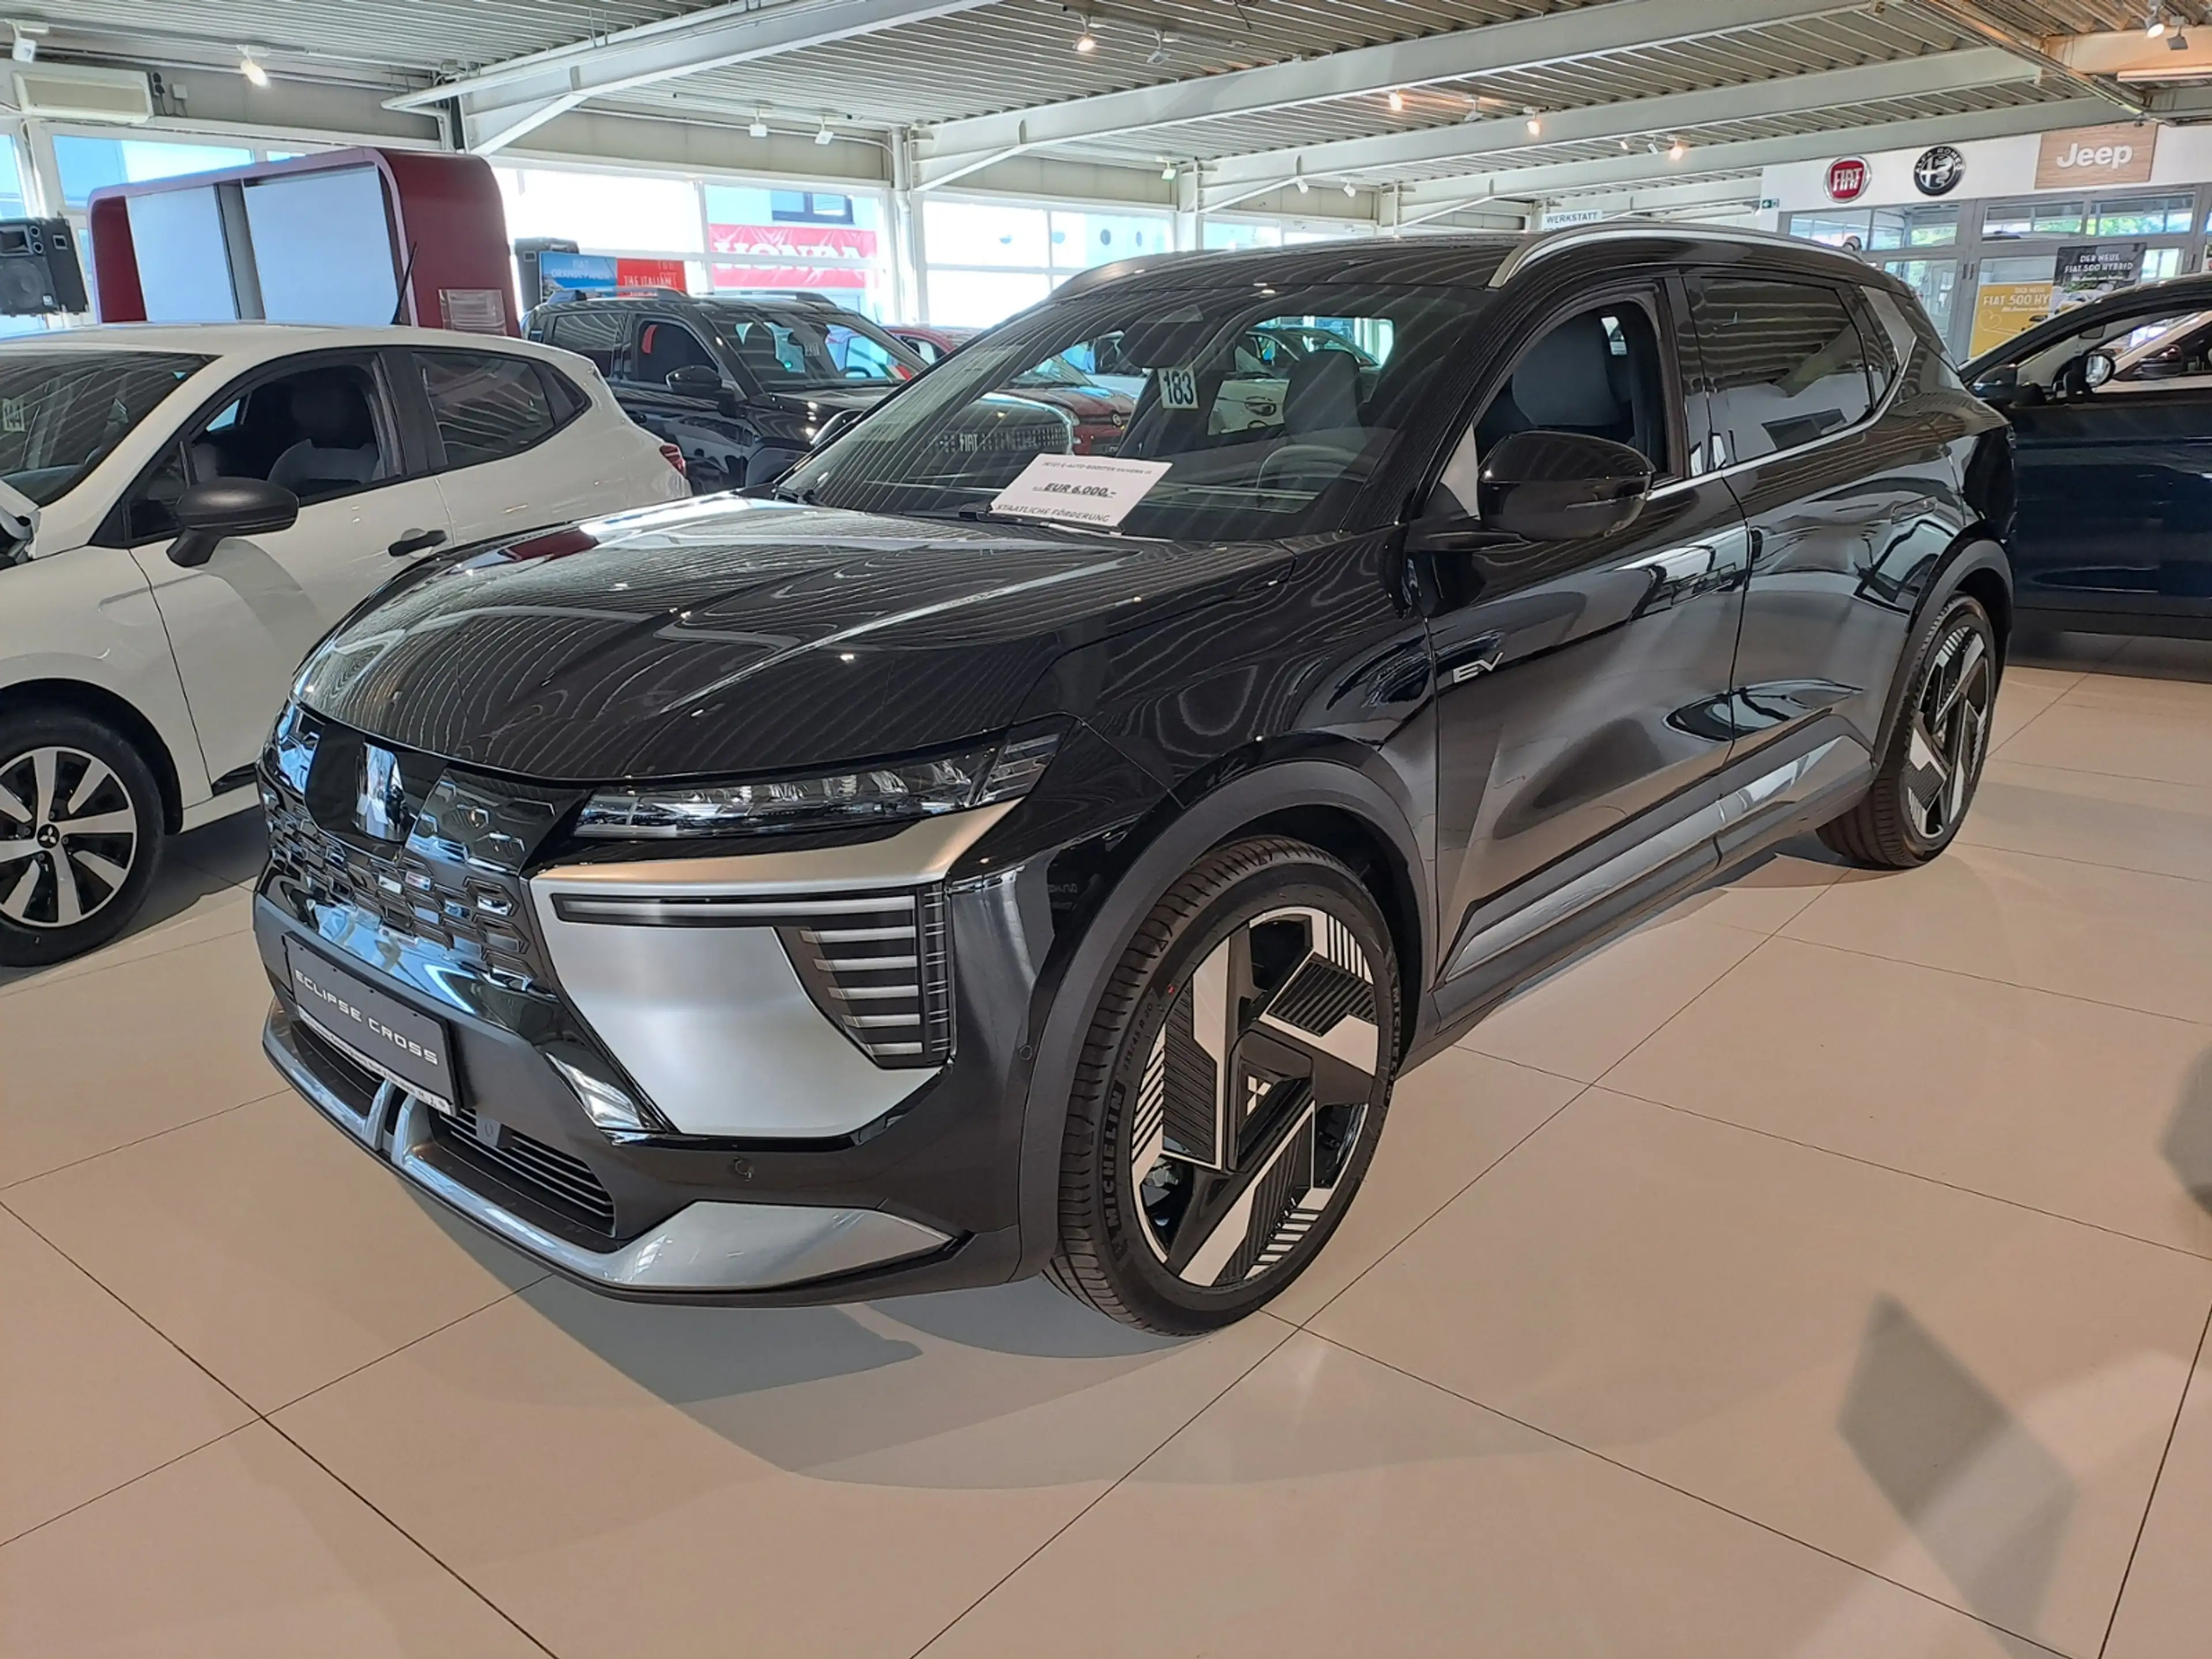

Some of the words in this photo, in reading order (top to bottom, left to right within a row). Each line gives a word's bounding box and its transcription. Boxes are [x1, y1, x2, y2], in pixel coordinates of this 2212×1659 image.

[1937, 148, 1963, 171] ROMEO
[2056, 142, 2133, 169] Jeep
[1833, 168, 1862, 191] FIAT
[1546, 211, 1598, 224] WERKSTATT
[2064, 265, 2082, 274] FIAT
[2083, 264, 2101, 272] 500
[2101, 262, 2134, 271] HYBRID
[2080, 254, 2097, 263] DER
[2097, 253, 2120, 262] NEUE
[1983, 295, 2004, 306] FIAT
[2009, 294, 2032, 305] 500
[1164, 370, 1194, 404] 183
[960, 433, 978, 452] FIAT
[1044, 482, 1071, 492] EUR
[1071, 485, 1117, 498] 6.000,-
[996, 504, 1051, 514] STAATLICHE
[1051, 507, 1111, 522] FÖRDERUNG
[1453, 652, 1505, 684] EV
[295, 969, 362, 1022] ECLIPSE
[368, 1017, 438, 1065] CROSS
[1103, 1090, 1124, 1228] MICHELIN
